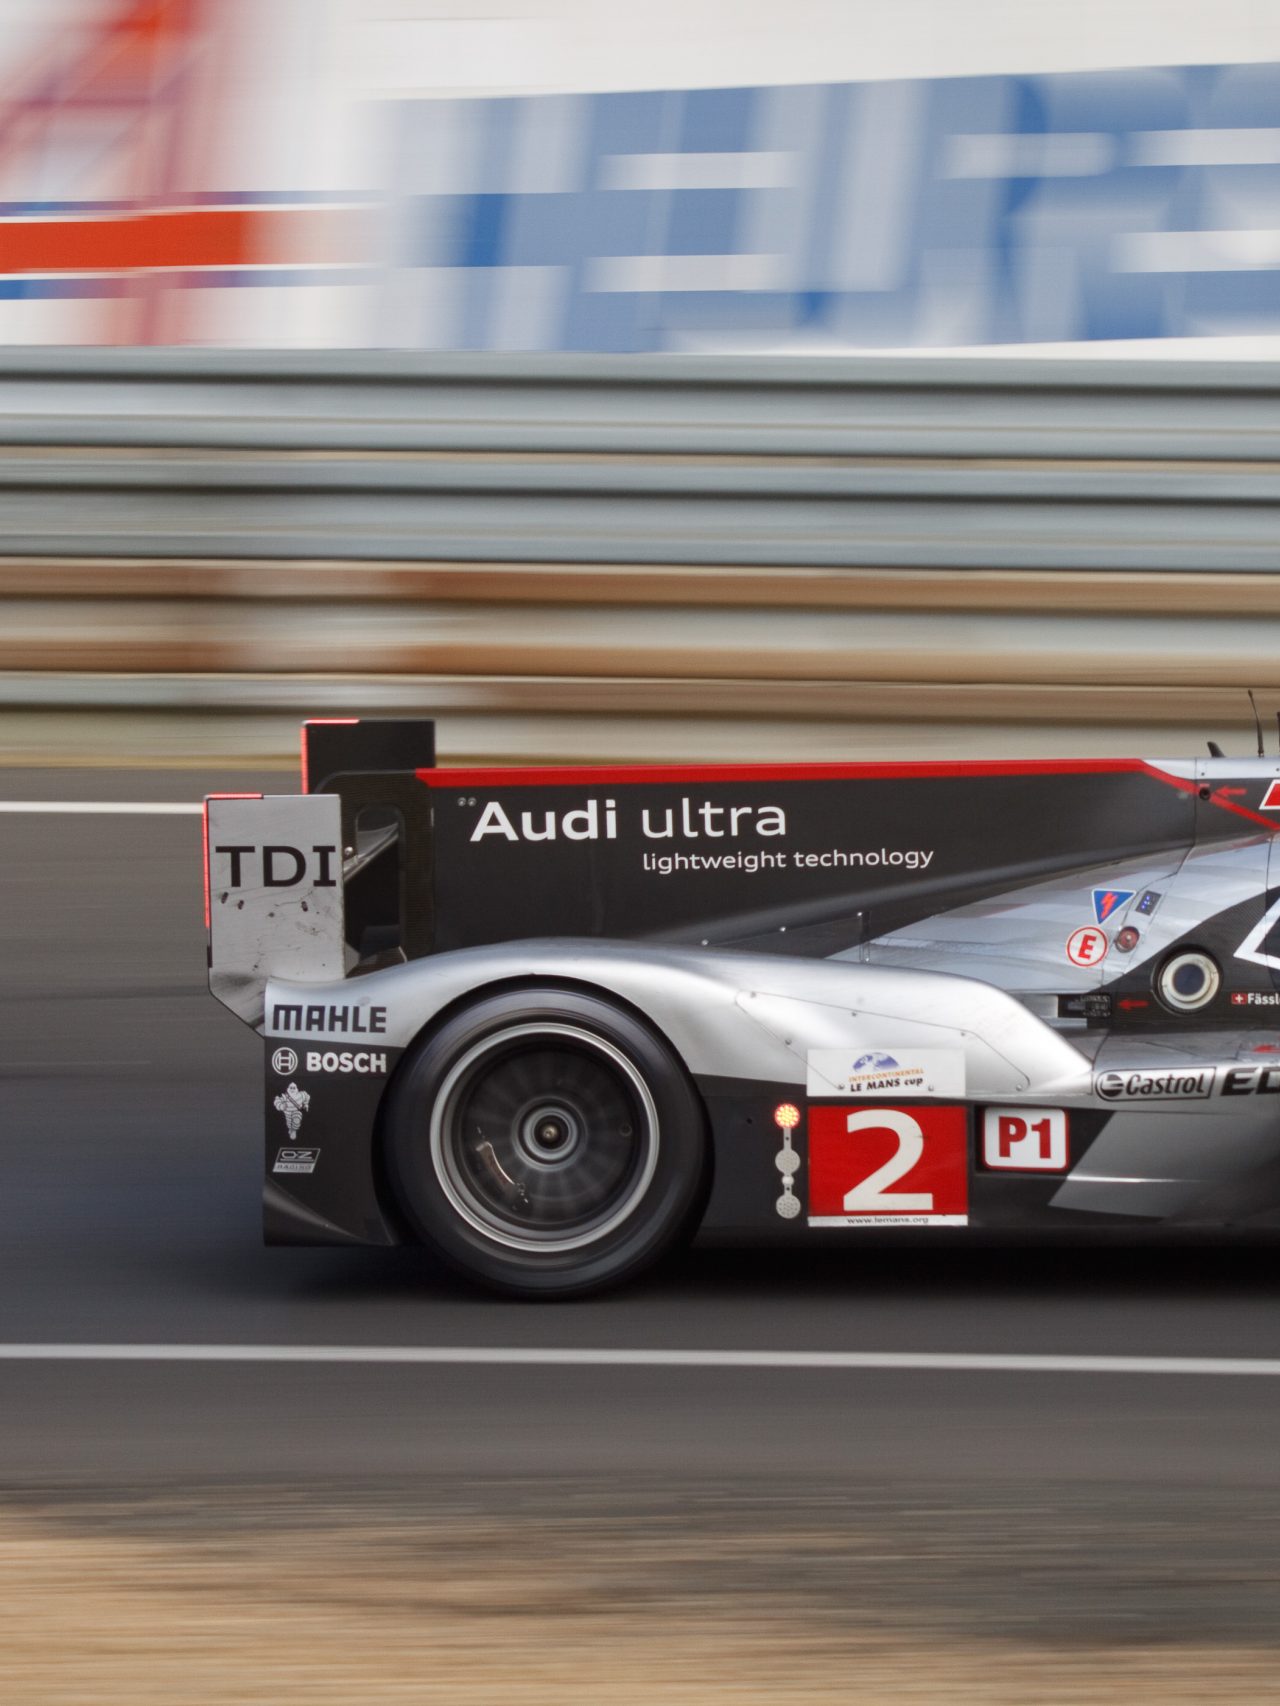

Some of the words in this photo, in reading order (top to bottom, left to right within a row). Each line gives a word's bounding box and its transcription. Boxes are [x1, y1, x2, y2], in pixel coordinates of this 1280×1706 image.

[470, 799, 617, 841] Audi
[641, 797, 788, 838] ultra
[215, 845, 337, 888] TDI
[642, 849, 787, 872] lightweight
[793, 846, 934, 871] technology
[1078, 934, 1097, 960] E
[272, 1004, 387, 1033] MAHLE
[306, 1052, 387, 1073] BOSCH
[850, 1083, 862, 1092] LE
[866, 1078, 901, 1090] MANS
[904, 1077, 923, 1086] cup
[1126, 1073, 1205, 1096] Castrol
[998, 1115, 1052, 1159] P1
[843, 1109, 933, 1211] 2
[847, 1216, 929, 1224] www.lemans.org
